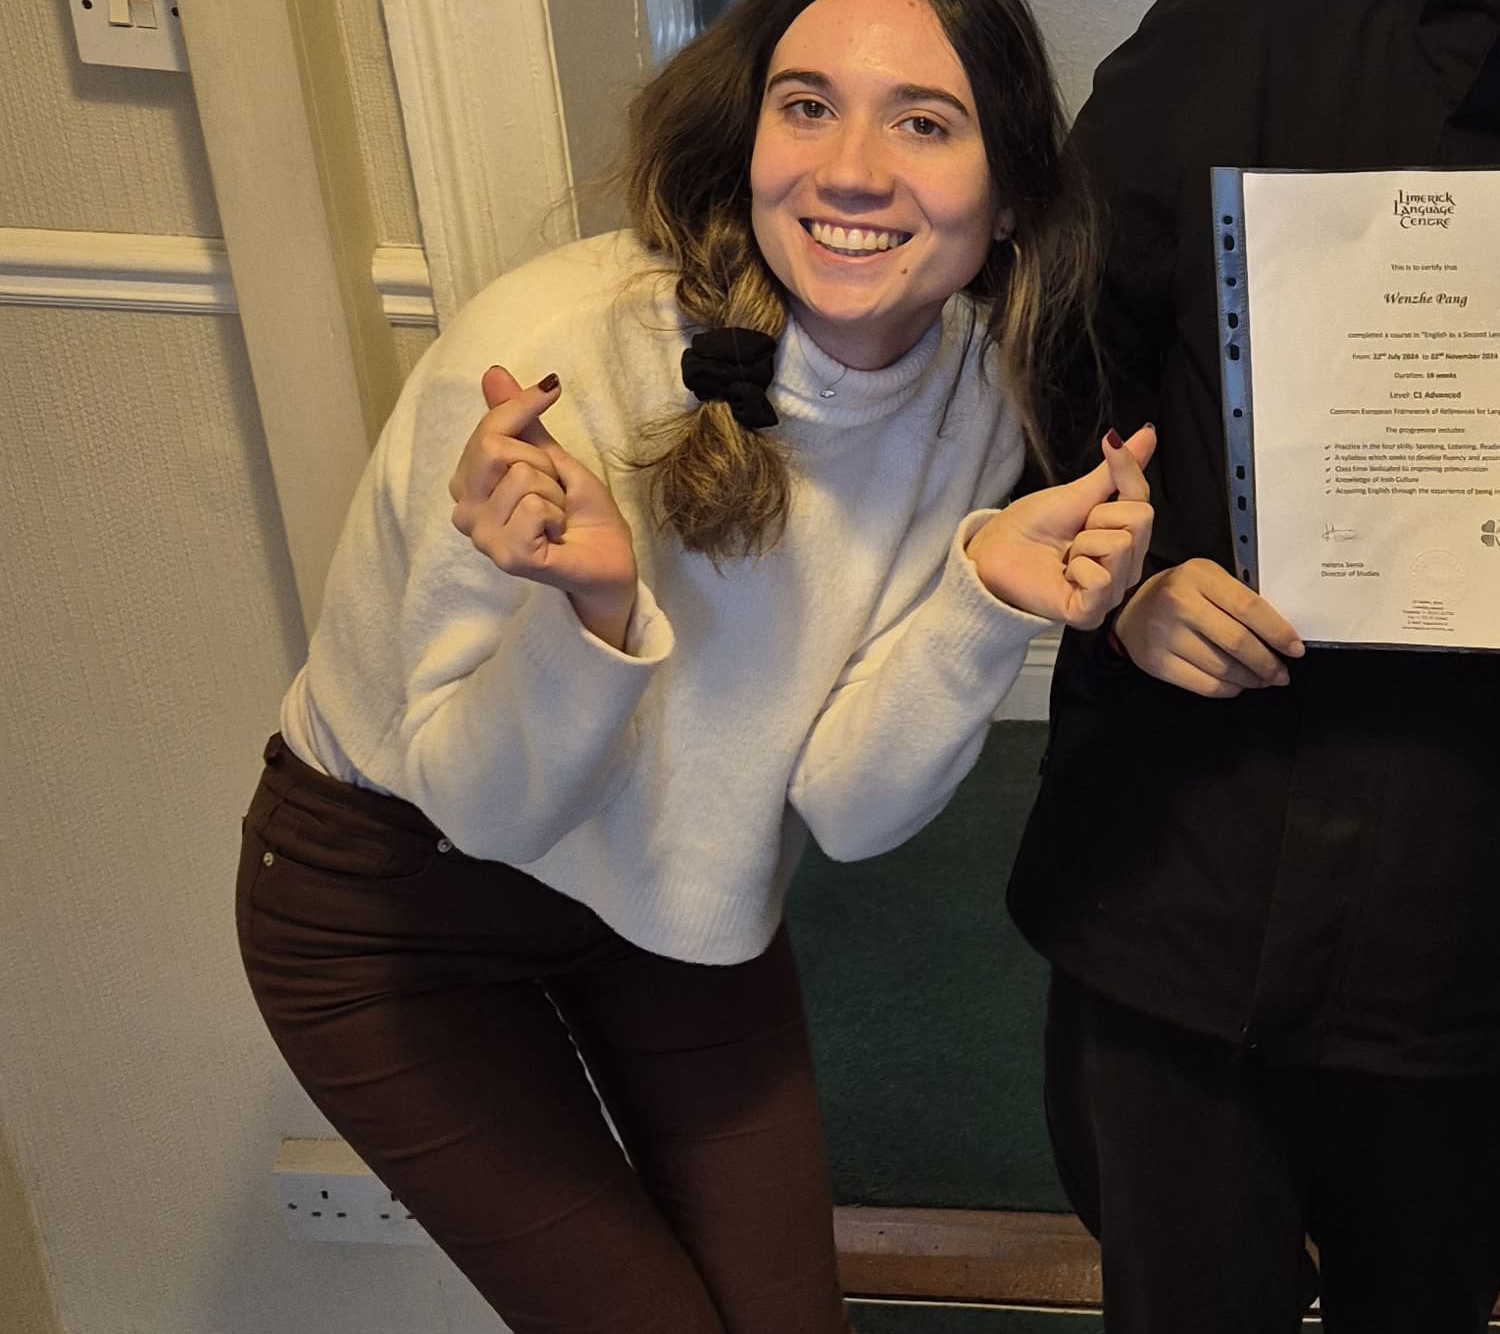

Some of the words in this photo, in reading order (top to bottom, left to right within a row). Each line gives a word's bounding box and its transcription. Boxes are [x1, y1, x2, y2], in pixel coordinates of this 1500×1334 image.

[1384, 291, 1433, 305] Wenzhe
[1435, 293, 1468, 308] Pang
[1425, 391, 1462, 399] Advanced
